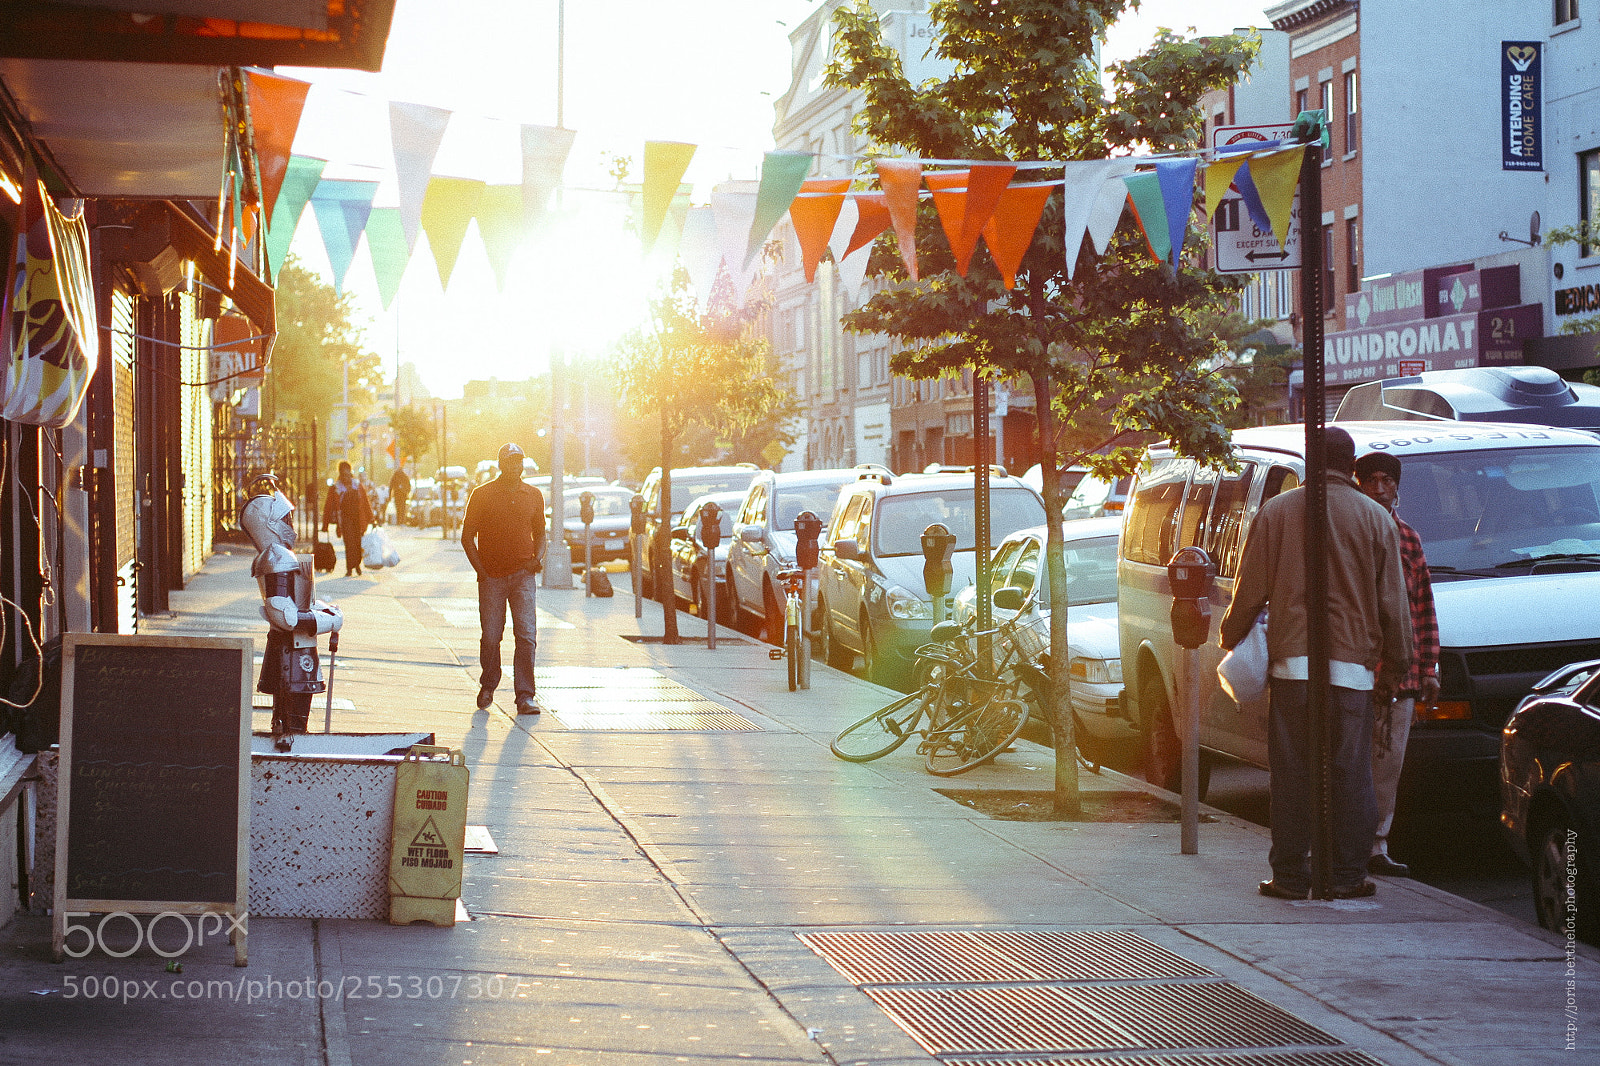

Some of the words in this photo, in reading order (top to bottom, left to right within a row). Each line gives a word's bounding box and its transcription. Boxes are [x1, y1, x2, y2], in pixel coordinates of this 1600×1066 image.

[1523, 75, 1535, 110] CARE
[1509, 74, 1522, 157] ATTENDING
[1523, 115, 1535, 157] HOME
[1236, 239, 1264, 249] EXCEPT
[1265, 238, 1297, 248] SUNAY
[1491, 317, 1515, 339] 24
[1324, 319, 1475, 367] AUNDROMAT
[416, 789, 448, 801] CAUTION
[416, 800, 447, 811] CUIDADO
[407, 847, 424, 858] WET
[426, 848, 449, 859] FLOOR
[401, 857, 419, 867] PISO
[421, 858, 453, 869] MOJADO
